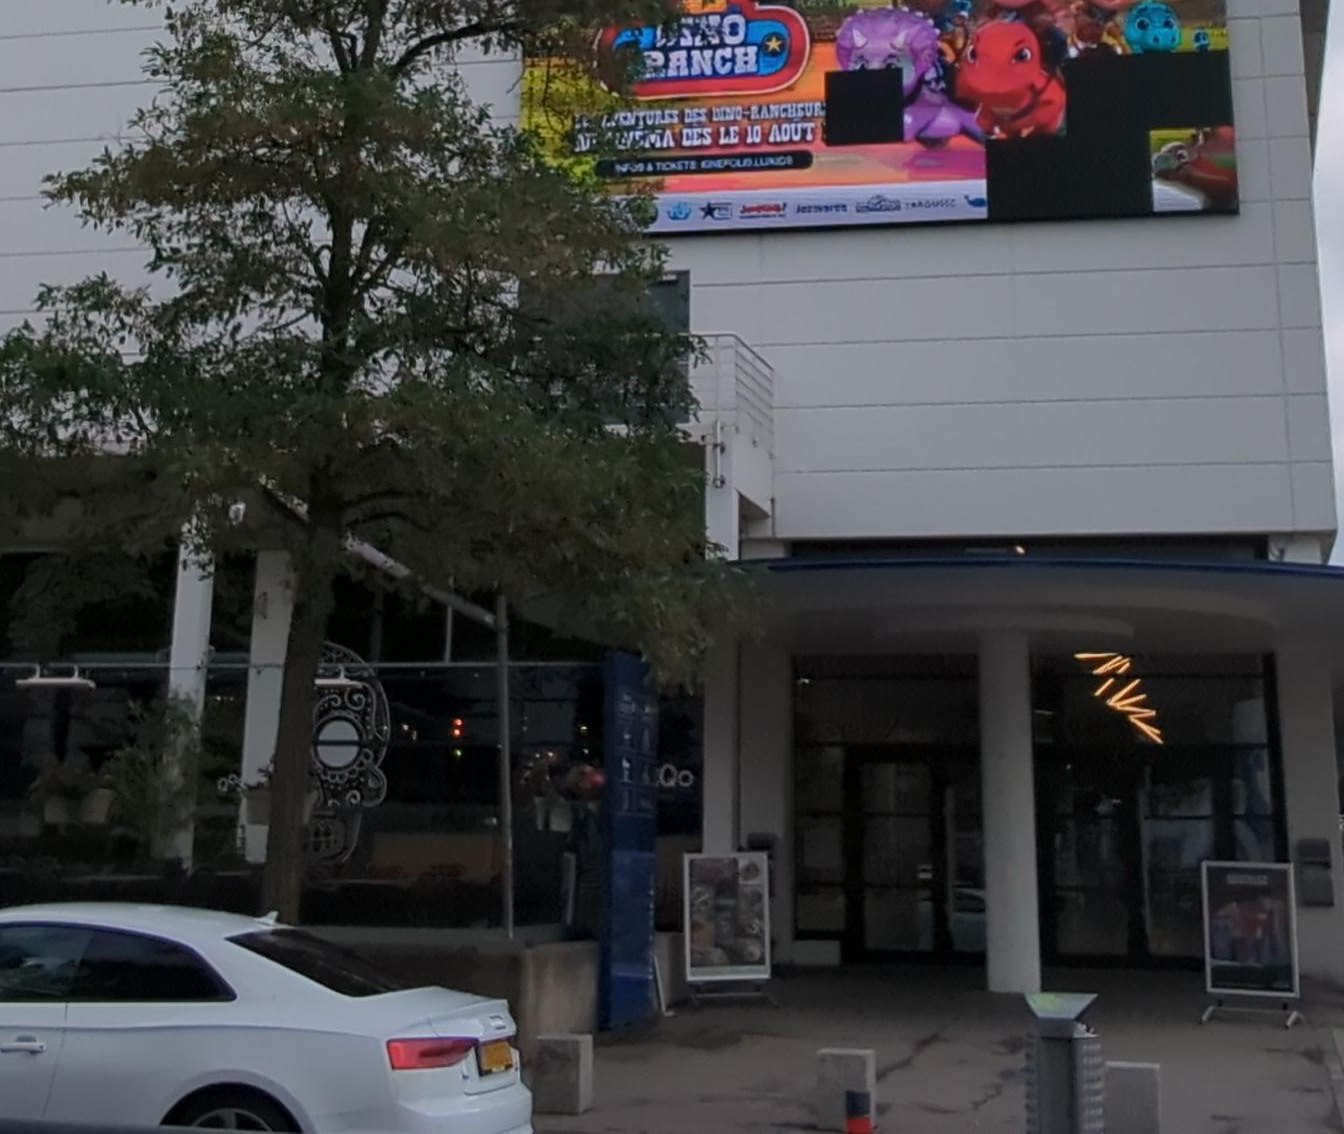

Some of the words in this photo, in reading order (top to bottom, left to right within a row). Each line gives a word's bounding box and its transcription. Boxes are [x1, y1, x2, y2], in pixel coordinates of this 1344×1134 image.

[643, 46, 758, 79] RANCH
[684, 107, 707, 122] DES
[719, 126, 739, 145] LE
[747, 126, 762, 143] 10
